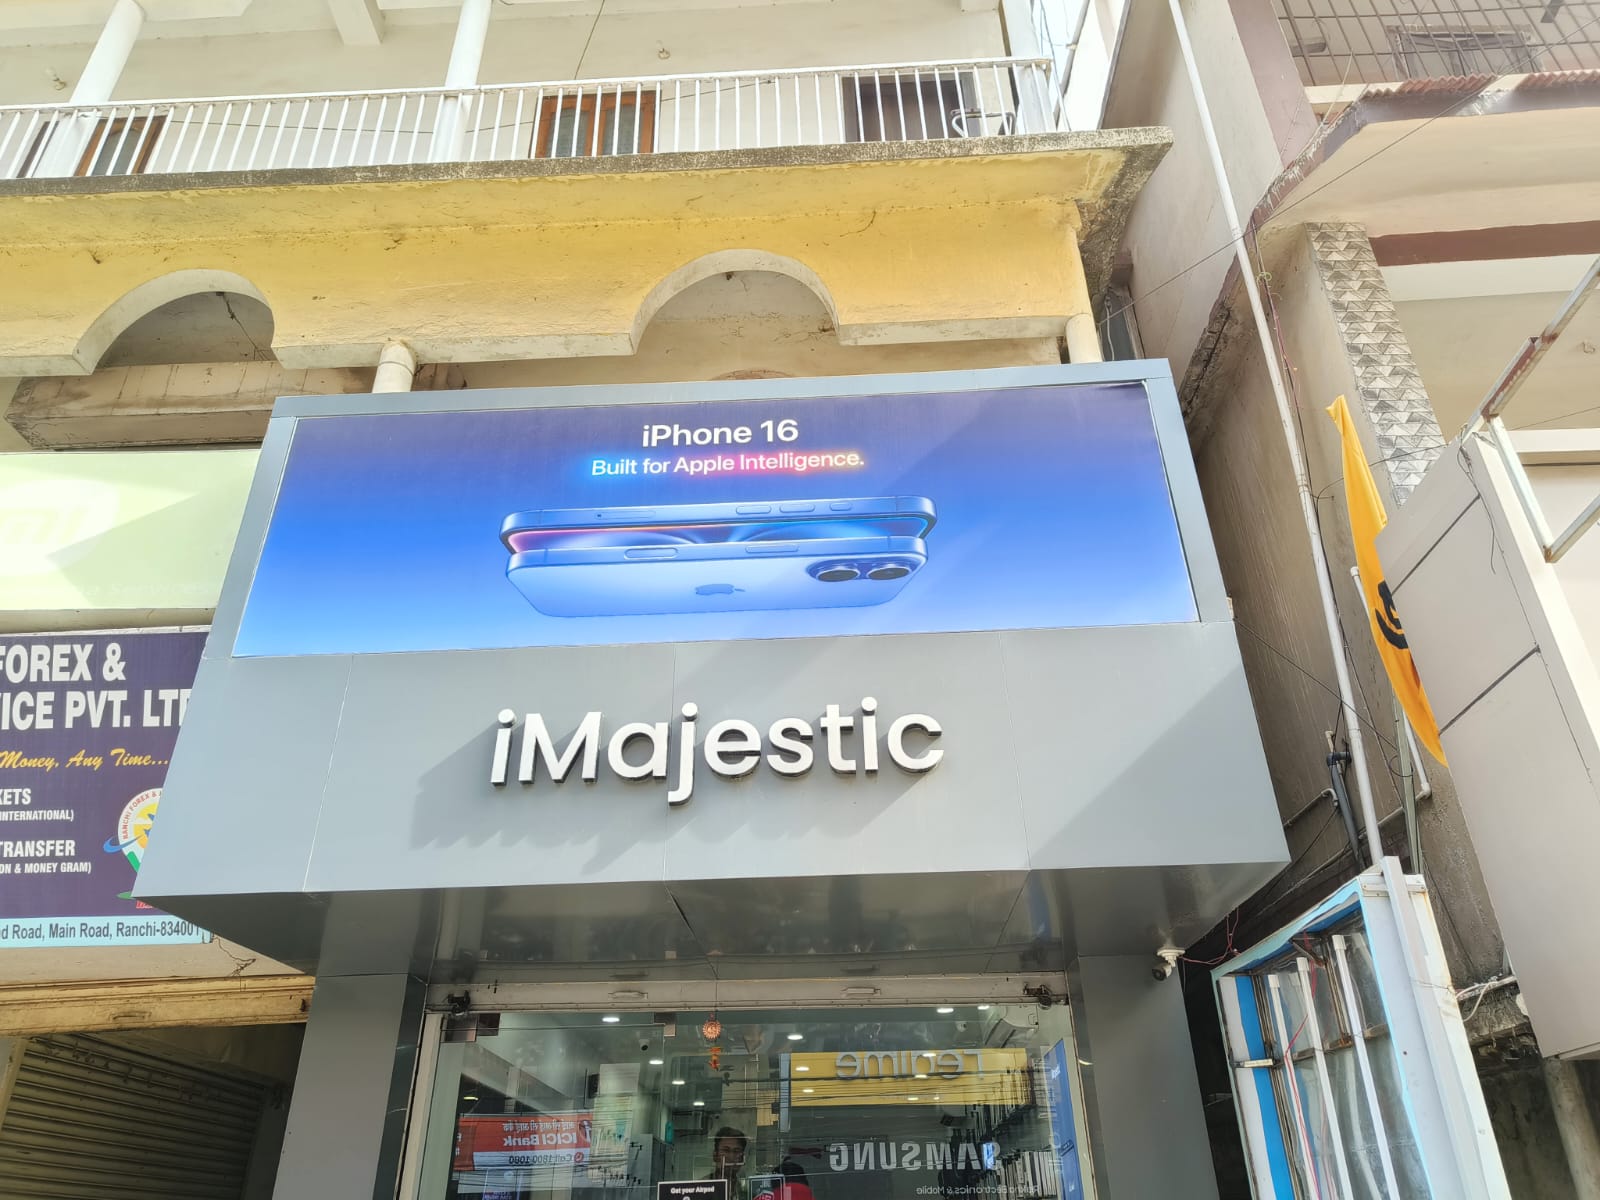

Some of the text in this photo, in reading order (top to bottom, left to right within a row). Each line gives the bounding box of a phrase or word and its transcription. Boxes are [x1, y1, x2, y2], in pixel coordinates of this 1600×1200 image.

[642, 419, 799, 447] iPhone 16
[591, 452, 865, 476] Built for Apple Intelligence.
[102, 643, 126, 681] &
[0, 690, 55, 731] ICE
[65, 690, 131, 728] PVT.
[0, 748, 168, 772] Money, Any Time...
[490, 696, 945, 806] iMajestic
[15, 863, 22, 874] &
[24, 863, 57, 873] MONEY
[61, 862, 91, 874] GRAM)
[12, 923, 45, 943] Road,
[49, 923, 76, 938] Main
[80, 922, 113, 940] Road,
